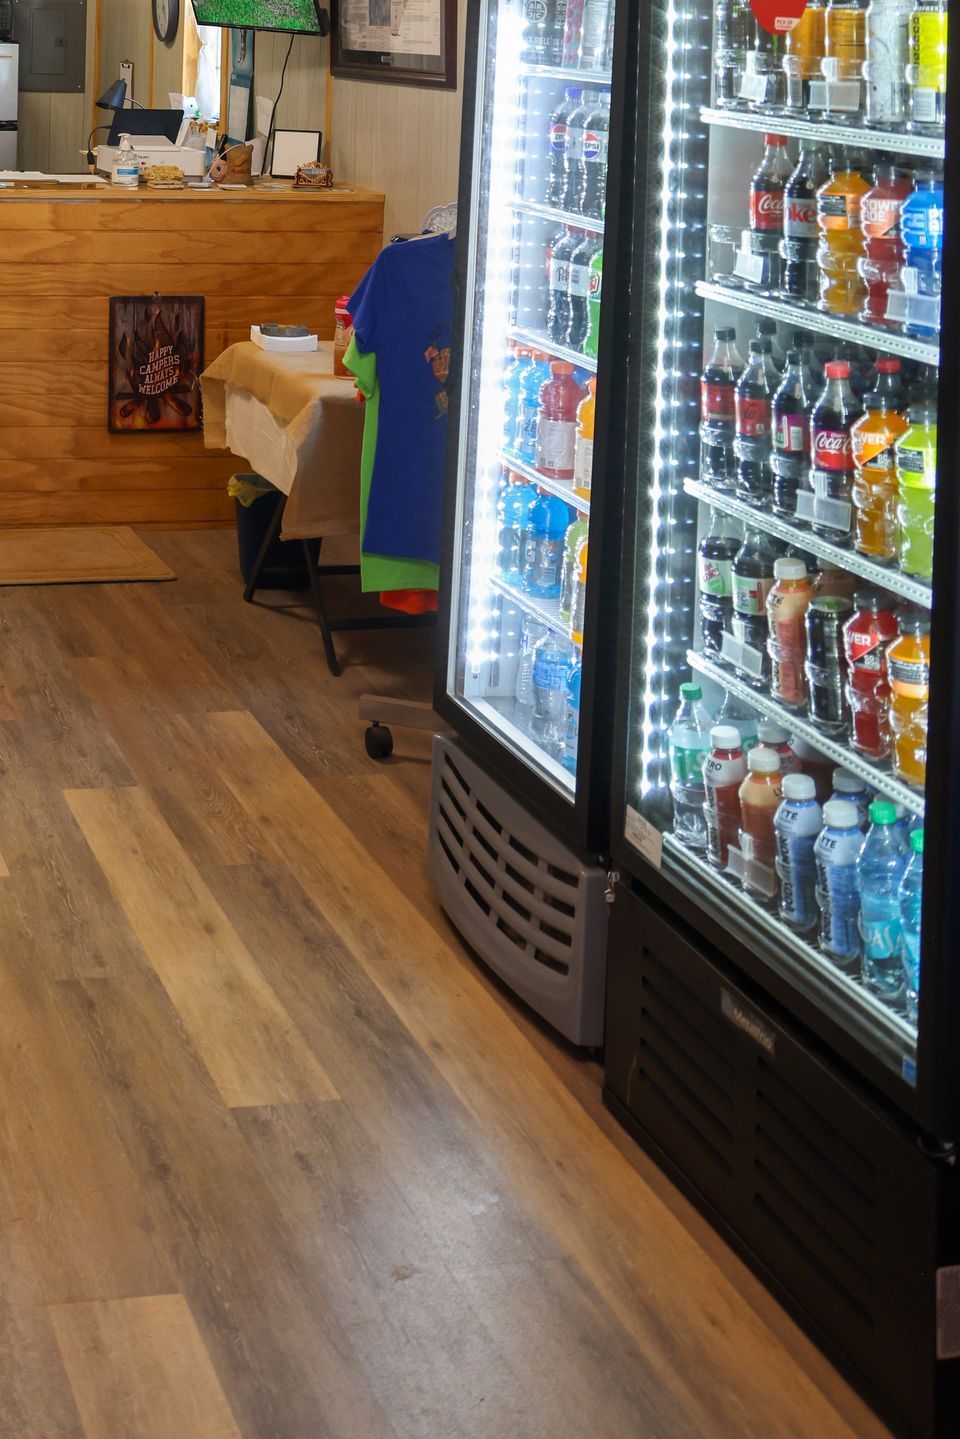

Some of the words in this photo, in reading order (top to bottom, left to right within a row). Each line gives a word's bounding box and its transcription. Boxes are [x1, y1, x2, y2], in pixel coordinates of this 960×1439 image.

[584, 142, 600, 150] EPSI
[148, 345, 174, 362] HAPPY
[139, 355, 180, 375] CAMPERS
[144, 366, 174, 384] ALWAYS
[138, 375, 179, 395] WELCOME
[781, 809, 798, 821] YTE
[819, 834, 837, 849] YTE
